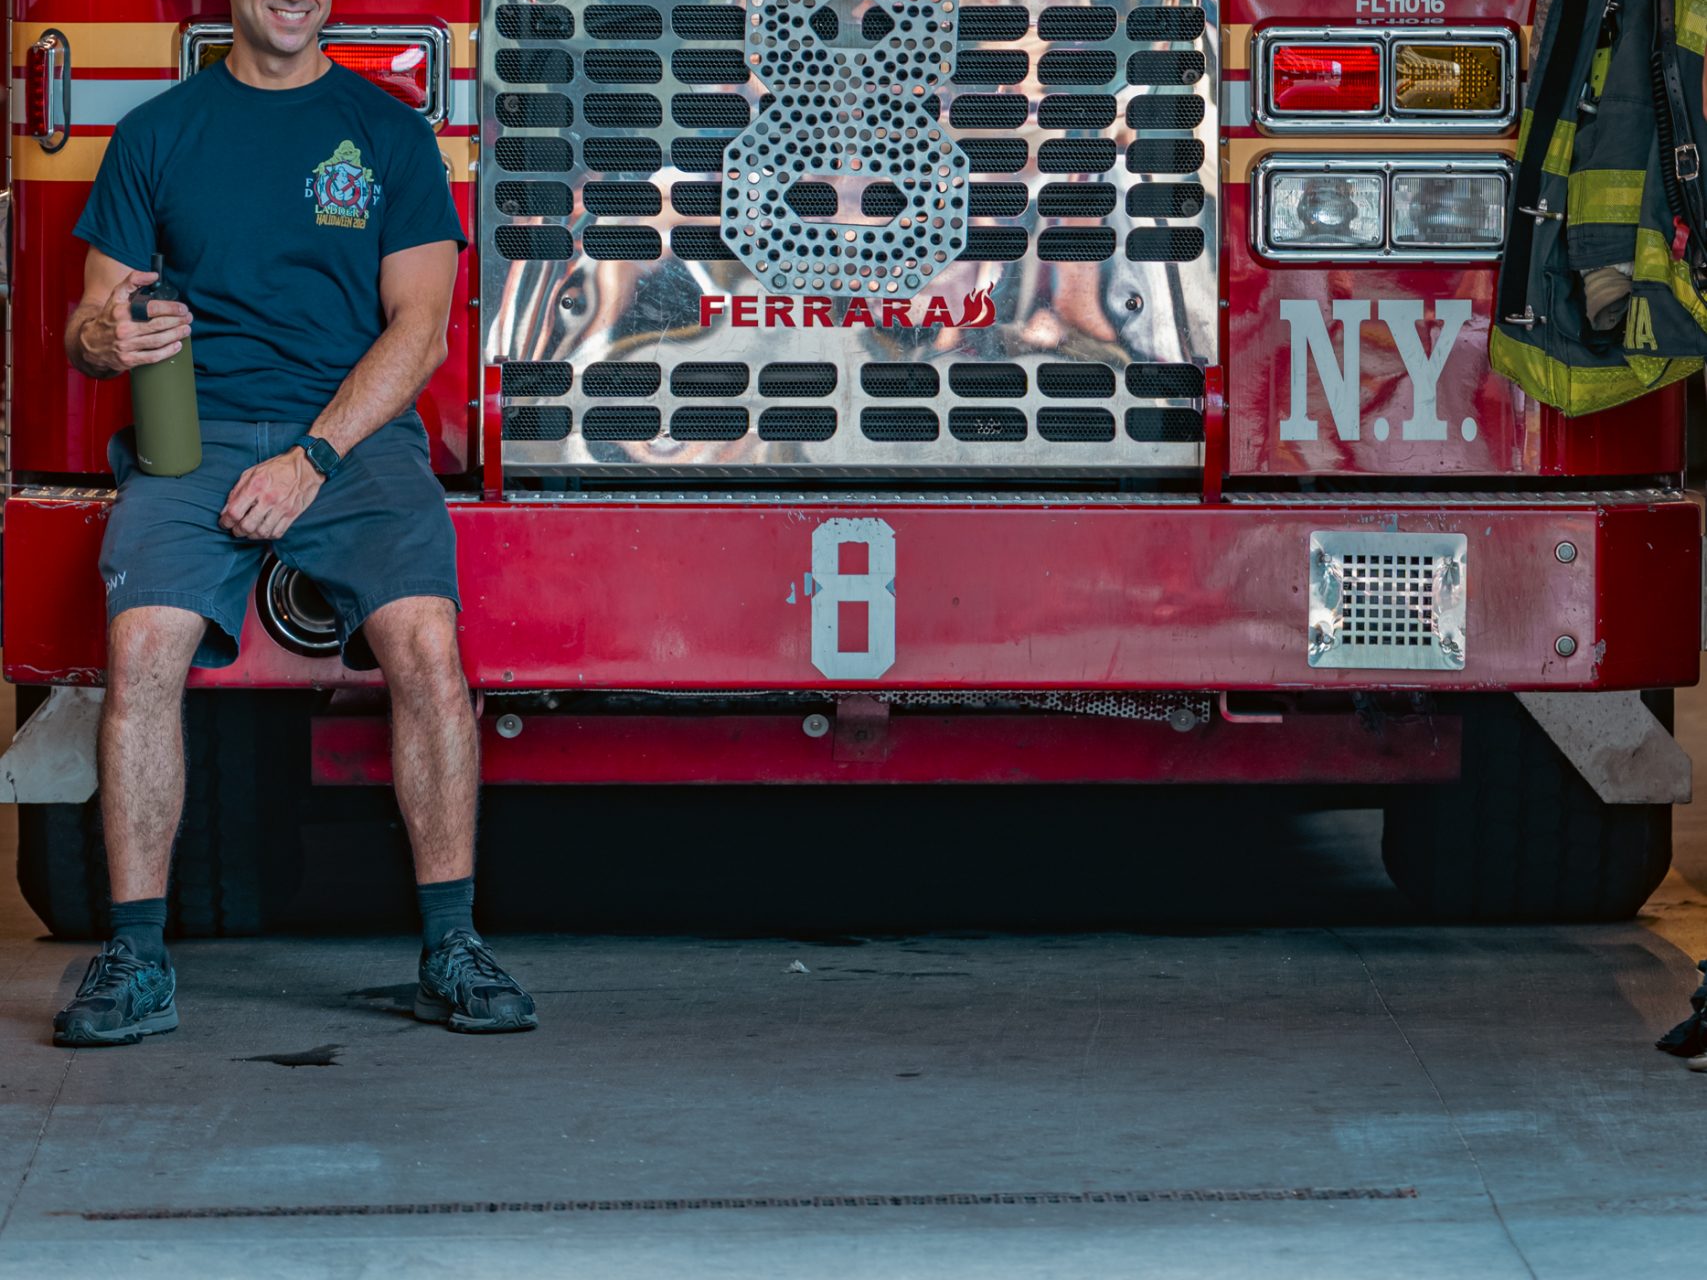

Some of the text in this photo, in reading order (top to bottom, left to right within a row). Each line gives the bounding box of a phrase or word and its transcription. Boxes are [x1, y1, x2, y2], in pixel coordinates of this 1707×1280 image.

[315, 204, 360, 218] LADDER
[699, 295, 954, 328] FERRARA
[1279, 299, 1477, 442] N.Y.
[811, 517, 896, 680] 8
